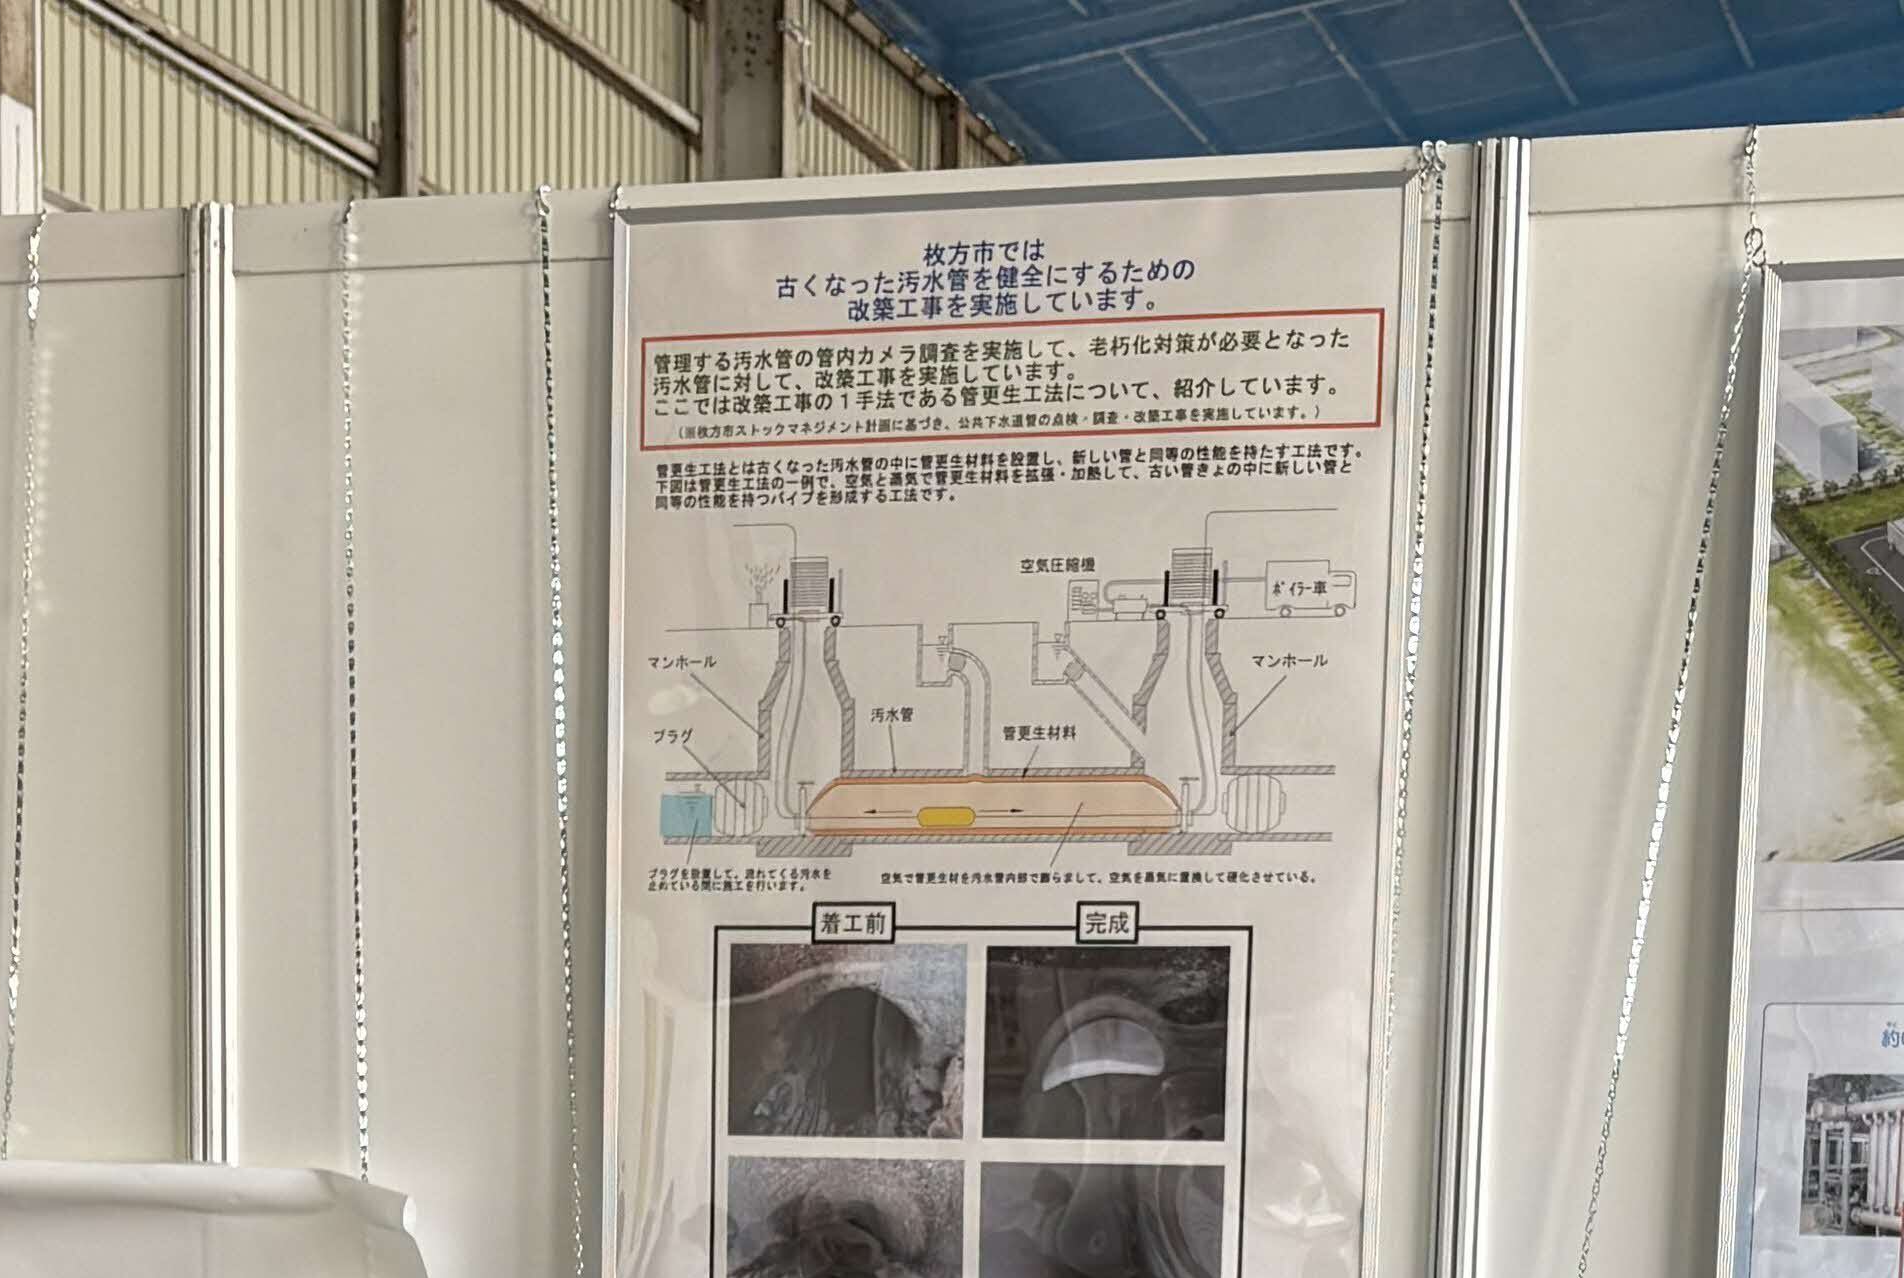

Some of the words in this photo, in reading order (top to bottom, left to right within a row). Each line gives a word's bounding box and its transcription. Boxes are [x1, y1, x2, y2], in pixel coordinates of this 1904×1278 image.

[923, 238, 1045, 267] 枚方市では
[776, 258, 1196, 299] 古くなった汚水管を健全にするための
[848, 286, 1157, 322] 改築工事を実施しています。
[653, 327, 1350, 375] 管理する汚水管の管内カメラ調査を実施して、老朽化対策が必要となった
[653, 362, 1077, 396] 汚水管に対して、改築工事を実施しています。
[1019, 556, 1096, 575] 空気圧縮機
[647, 654, 717, 671] マンホール
[1251, 652, 1329, 670] マンホール
[870, 706, 914, 724] 汚水管
[653, 728, 695, 746] プラグ
[1002, 724, 1078, 743] 管更生材料
[820, 912, 887, 936] 着工前
[1084, 910, 1130, 935] 完成
